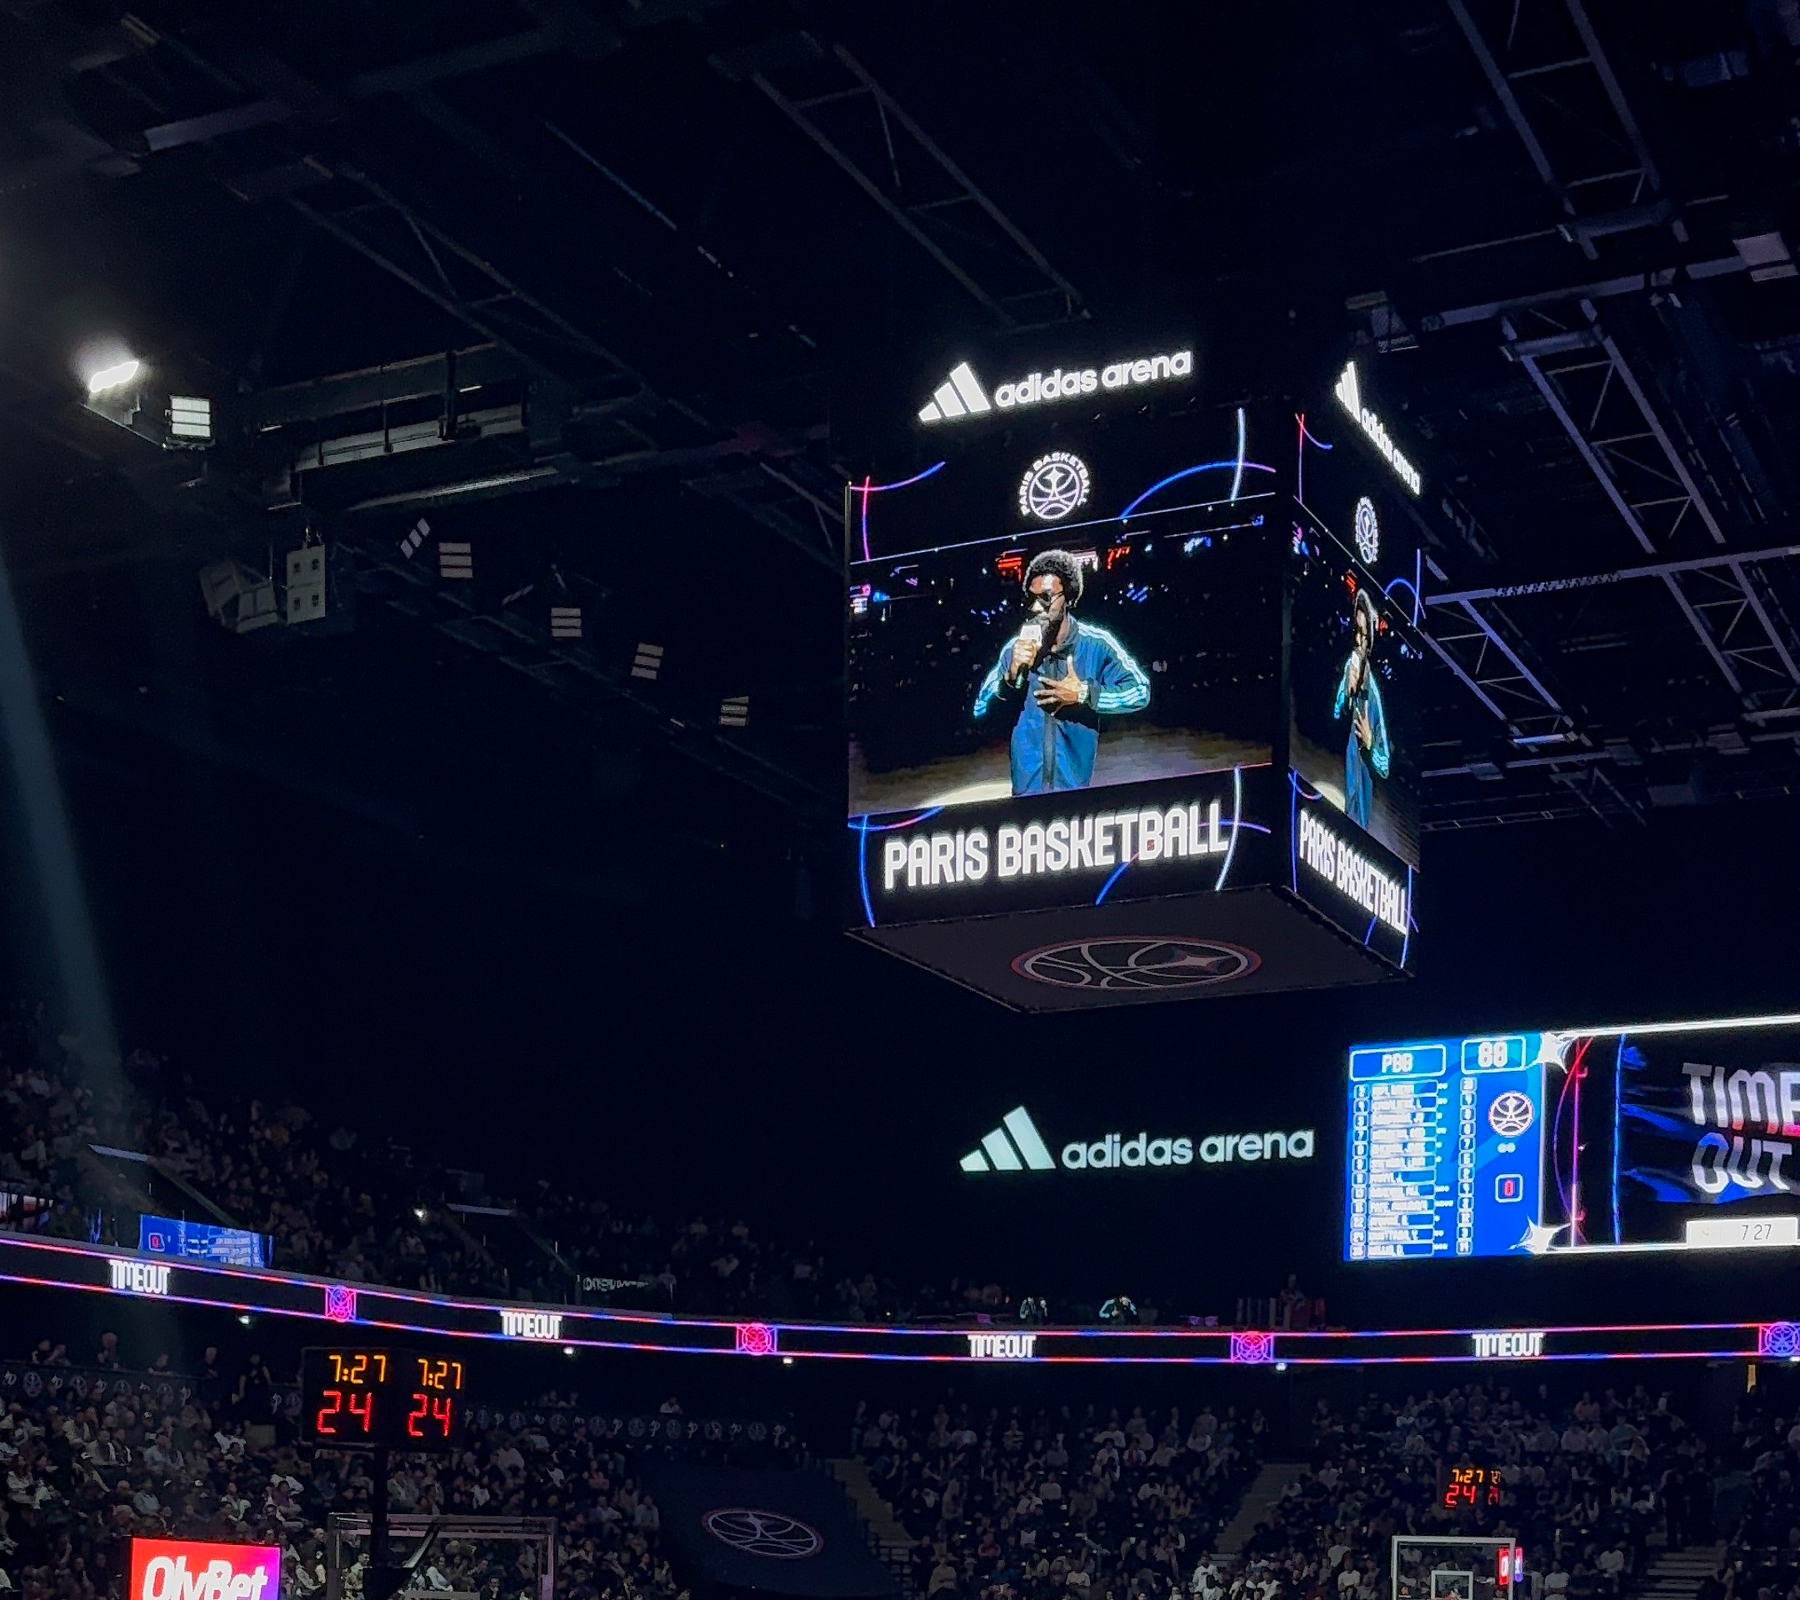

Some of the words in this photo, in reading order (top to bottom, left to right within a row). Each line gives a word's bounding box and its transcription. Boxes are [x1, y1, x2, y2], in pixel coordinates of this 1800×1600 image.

[995, 369, 1097, 407] adidas
[1101, 351, 1192, 388] arena
[1361, 407, 1393, 462] adidas
[1018, 471, 1034, 516] PARIS
[1033, 452, 1091, 506] BASKETBALL
[885, 836, 988, 889] PARIS
[998, 803, 1229, 877] BASKETBALL
[1300, 811, 1335, 880] PARIS
[1335, 843, 1408, 935] BASKETBALL
[1682, 1062, 1800, 1136] TIME
[1061, 1132, 1193, 1169] adidas
[1199, 1129, 1315, 1163] arena
[1691, 1132, 1793, 1193] OUT
[109, 1259, 170, 1295] TIMEOUT
[501, 1311, 563, 1339] TIMEOUT
[1472, 1332, 1545, 1357] TIMEOUT
[967, 1334, 1037, 1358] TIMEOUT
[329, 1354, 386, 1384] 7:27
[418, 1358, 462, 1390] 7:27
[316, 1390, 373, 1433] 24
[408, 1394, 452, 1437] 24
[1445, 1484, 1477, 1506] 24
[1452, 1469, 1485, 1484] 7:27
